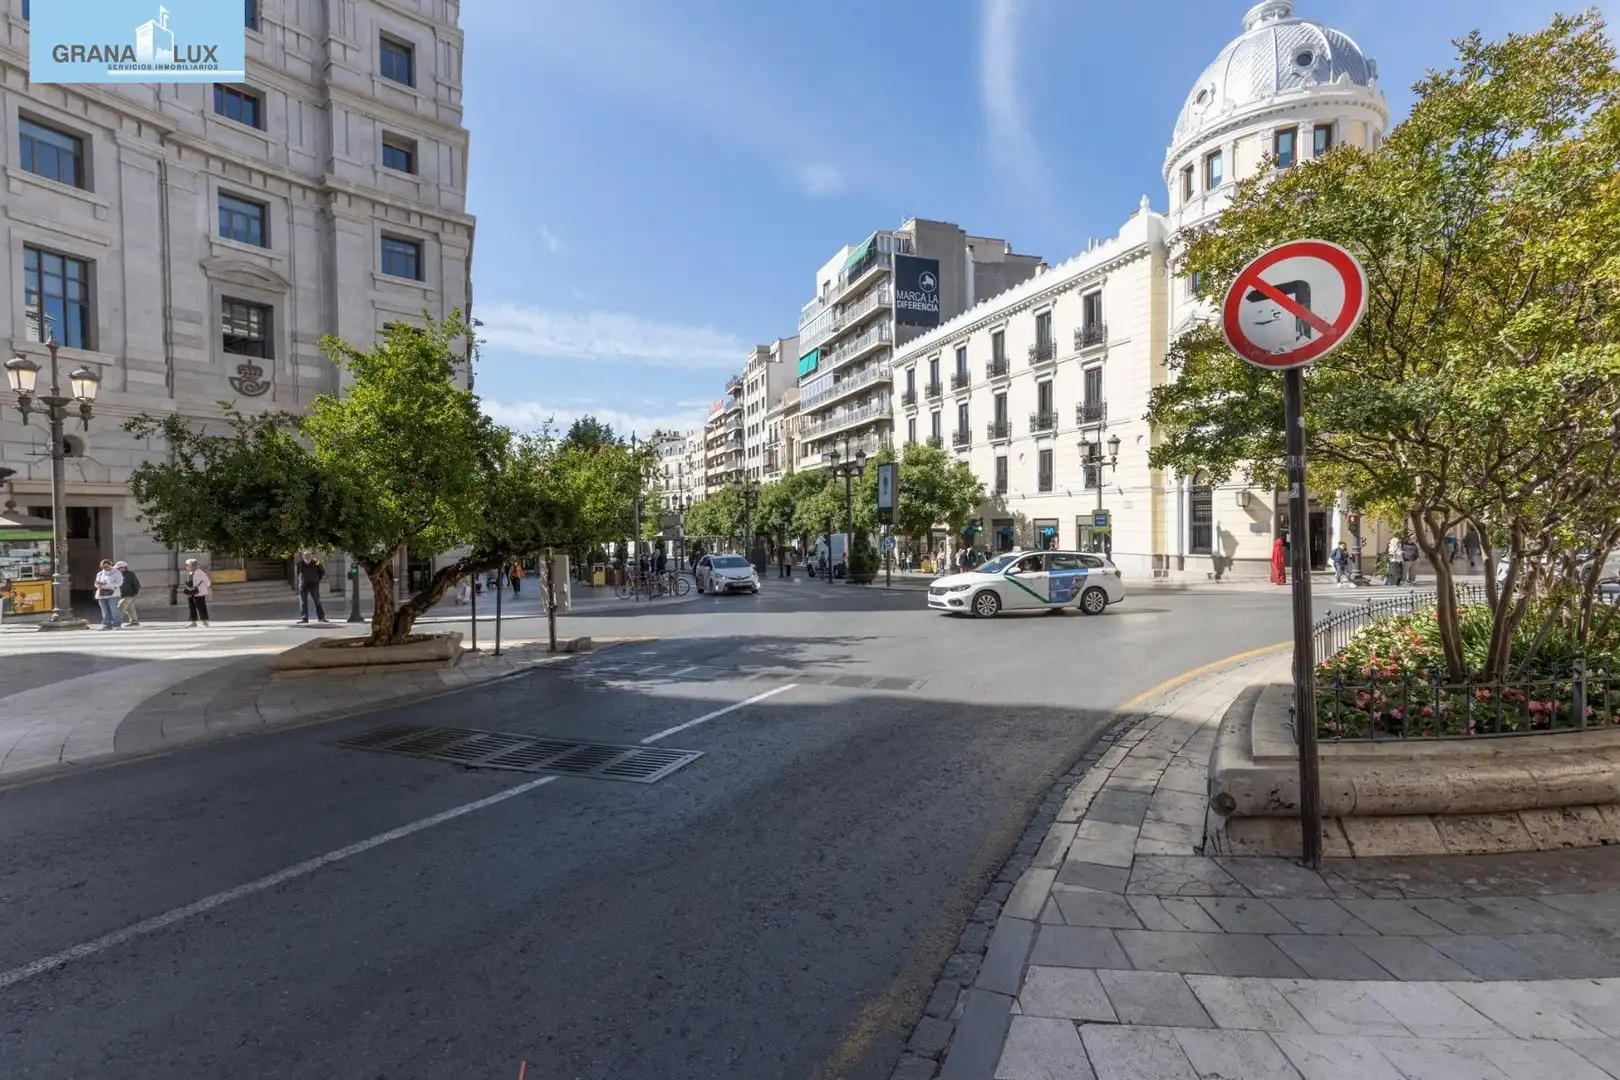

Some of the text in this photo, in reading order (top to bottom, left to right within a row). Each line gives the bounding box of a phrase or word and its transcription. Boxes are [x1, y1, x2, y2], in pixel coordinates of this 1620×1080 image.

[896, 289, 939, 304] MARCA LA
[896, 300, 939, 312] DIFERENCIA
